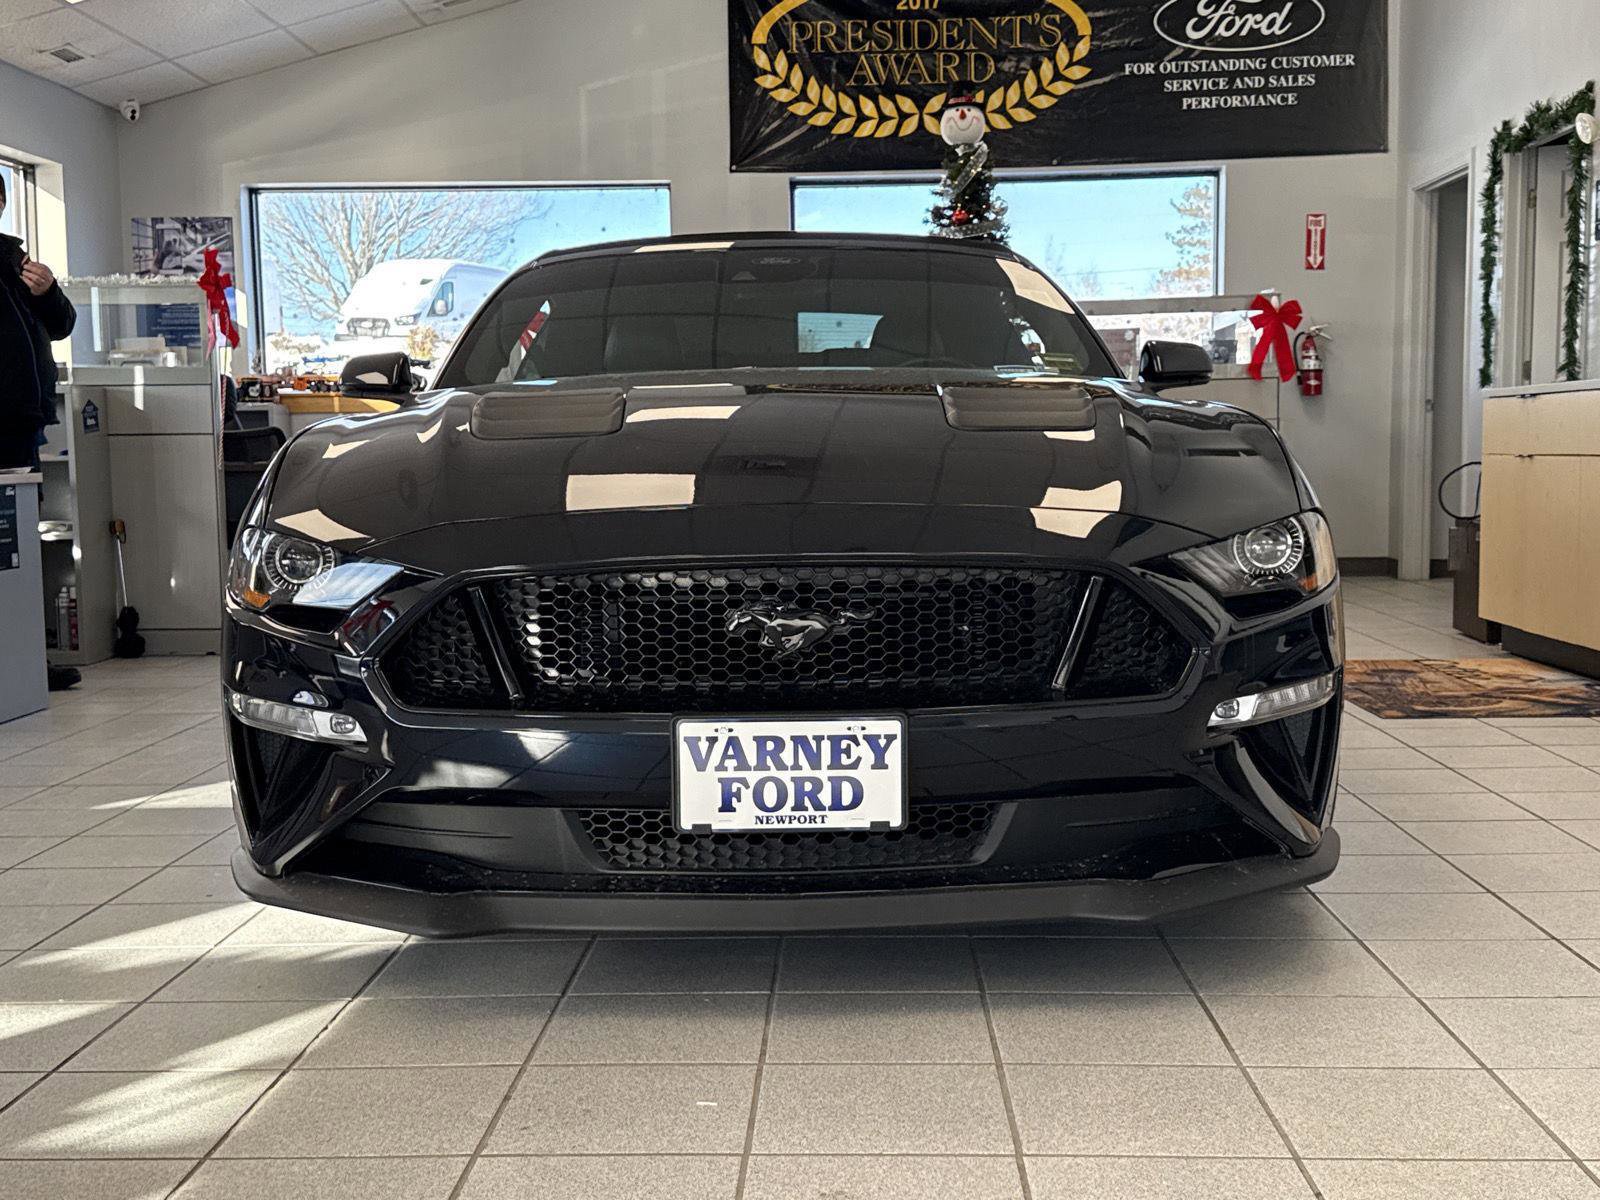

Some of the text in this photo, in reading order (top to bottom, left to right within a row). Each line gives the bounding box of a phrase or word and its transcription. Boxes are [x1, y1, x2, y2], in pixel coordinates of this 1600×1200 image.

[787, 14, 1062, 54] PRESIDENT'S
[1185, 0, 1293, 40] Ford
[847, 52, 995, 86] AWARD
[1124, 53, 1356, 75] FOR OUTSTANDING CUSTOMER
[1163, 74, 1316, 92] SERVICE AND SALES
[1182, 93, 1298, 110] PERFORMANCE
[683, 734, 898, 772] VARNEY
[717, 775, 865, 813] FORD
[754, 814, 828, 825] NEWPORT
